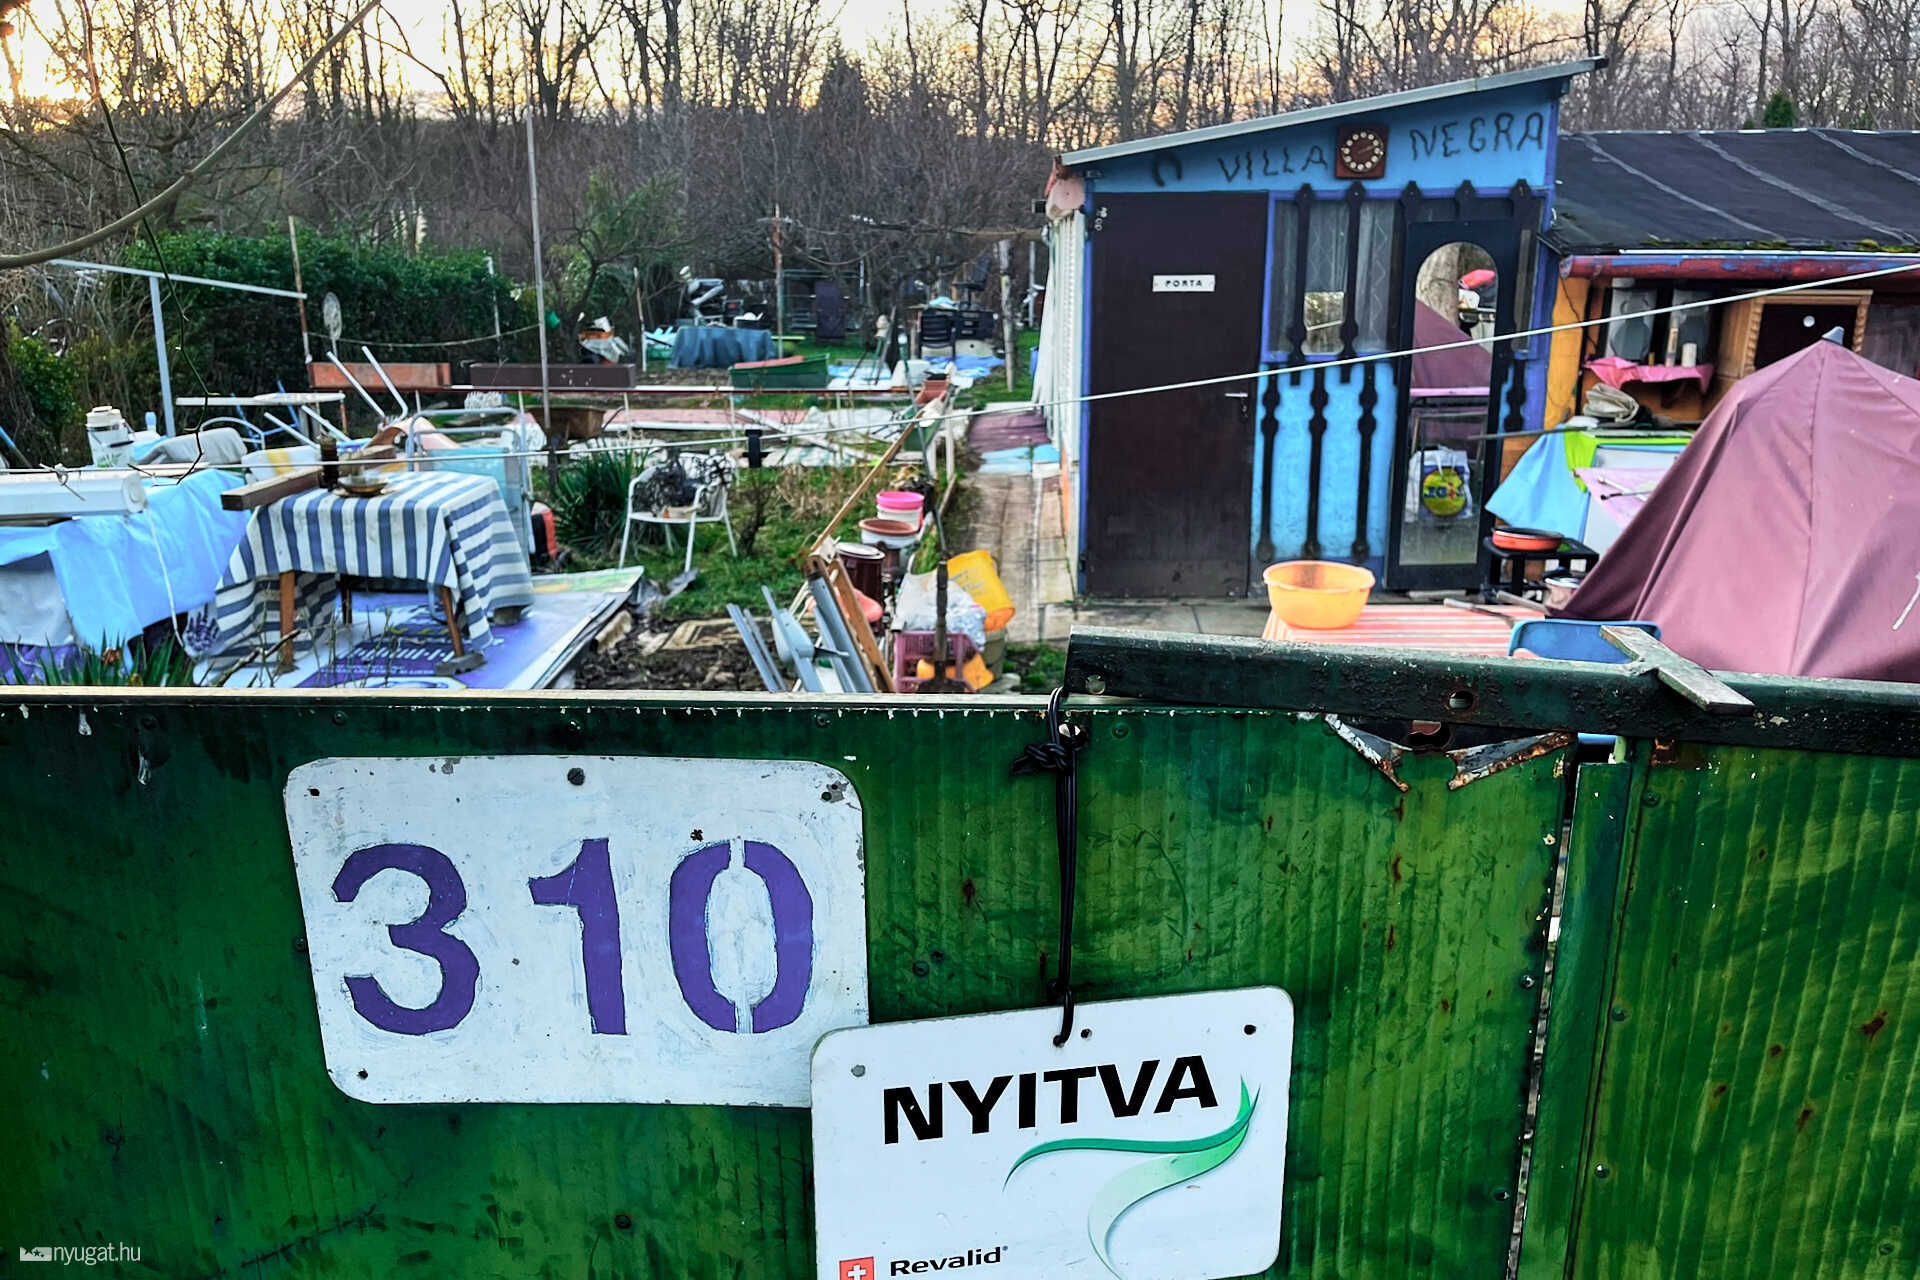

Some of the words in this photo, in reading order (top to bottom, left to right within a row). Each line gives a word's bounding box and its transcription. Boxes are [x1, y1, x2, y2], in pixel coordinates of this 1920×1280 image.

[1217, 145, 1328, 183] VILLA
[1409, 112, 1545, 161] NEGRA
[1165, 279, 1203, 287] PORTA
[330, 837, 814, 1037] 310
[883, 1054, 1219, 1145] NYITVA
